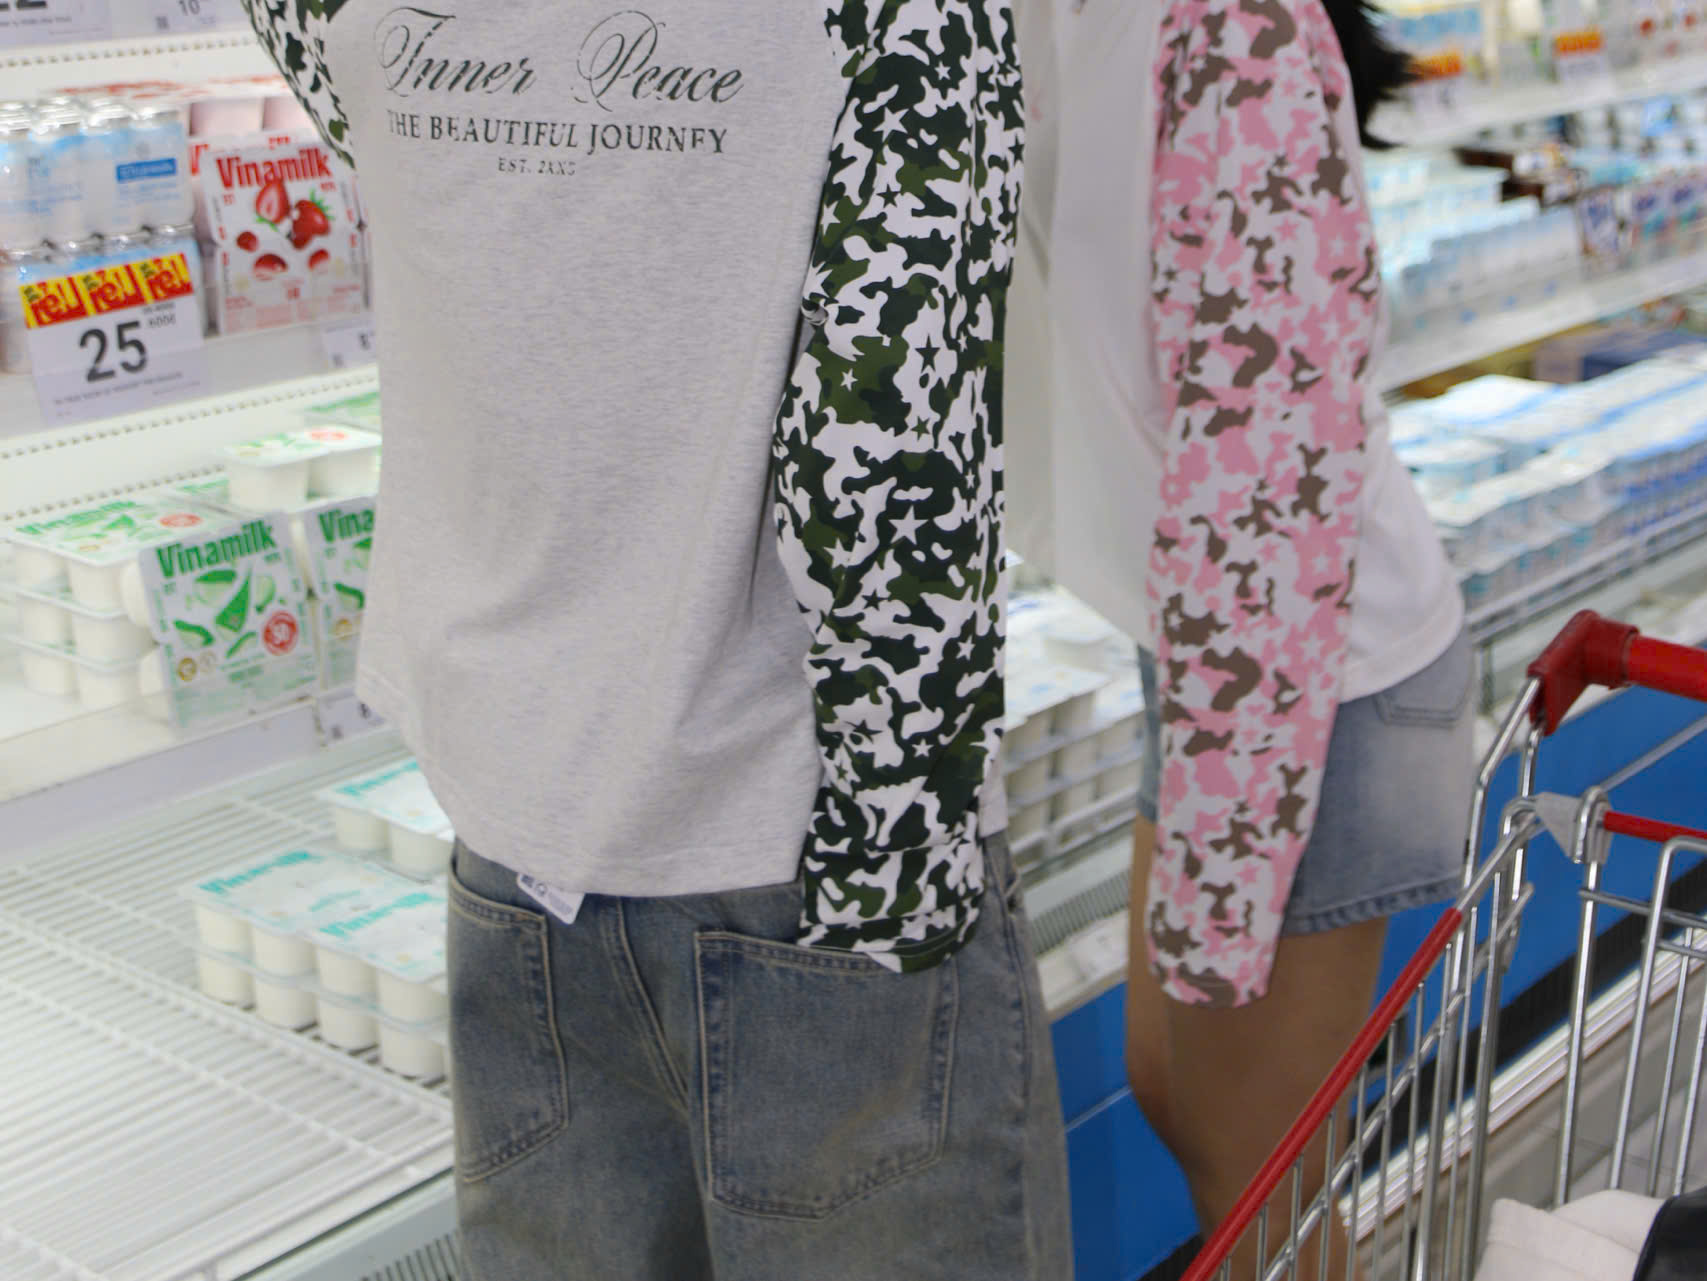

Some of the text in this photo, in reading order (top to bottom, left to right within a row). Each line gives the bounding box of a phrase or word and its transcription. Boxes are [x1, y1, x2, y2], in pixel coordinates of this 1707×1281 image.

[374, 7, 744, 112] Inner Peace
[387, 110, 728, 155] THE BEAUTIFUL JOURNEY
[215, 147, 332, 191] Vinamilk
[79, 320, 148, 382] 25
[155, 519, 277, 579] Vinamilk
